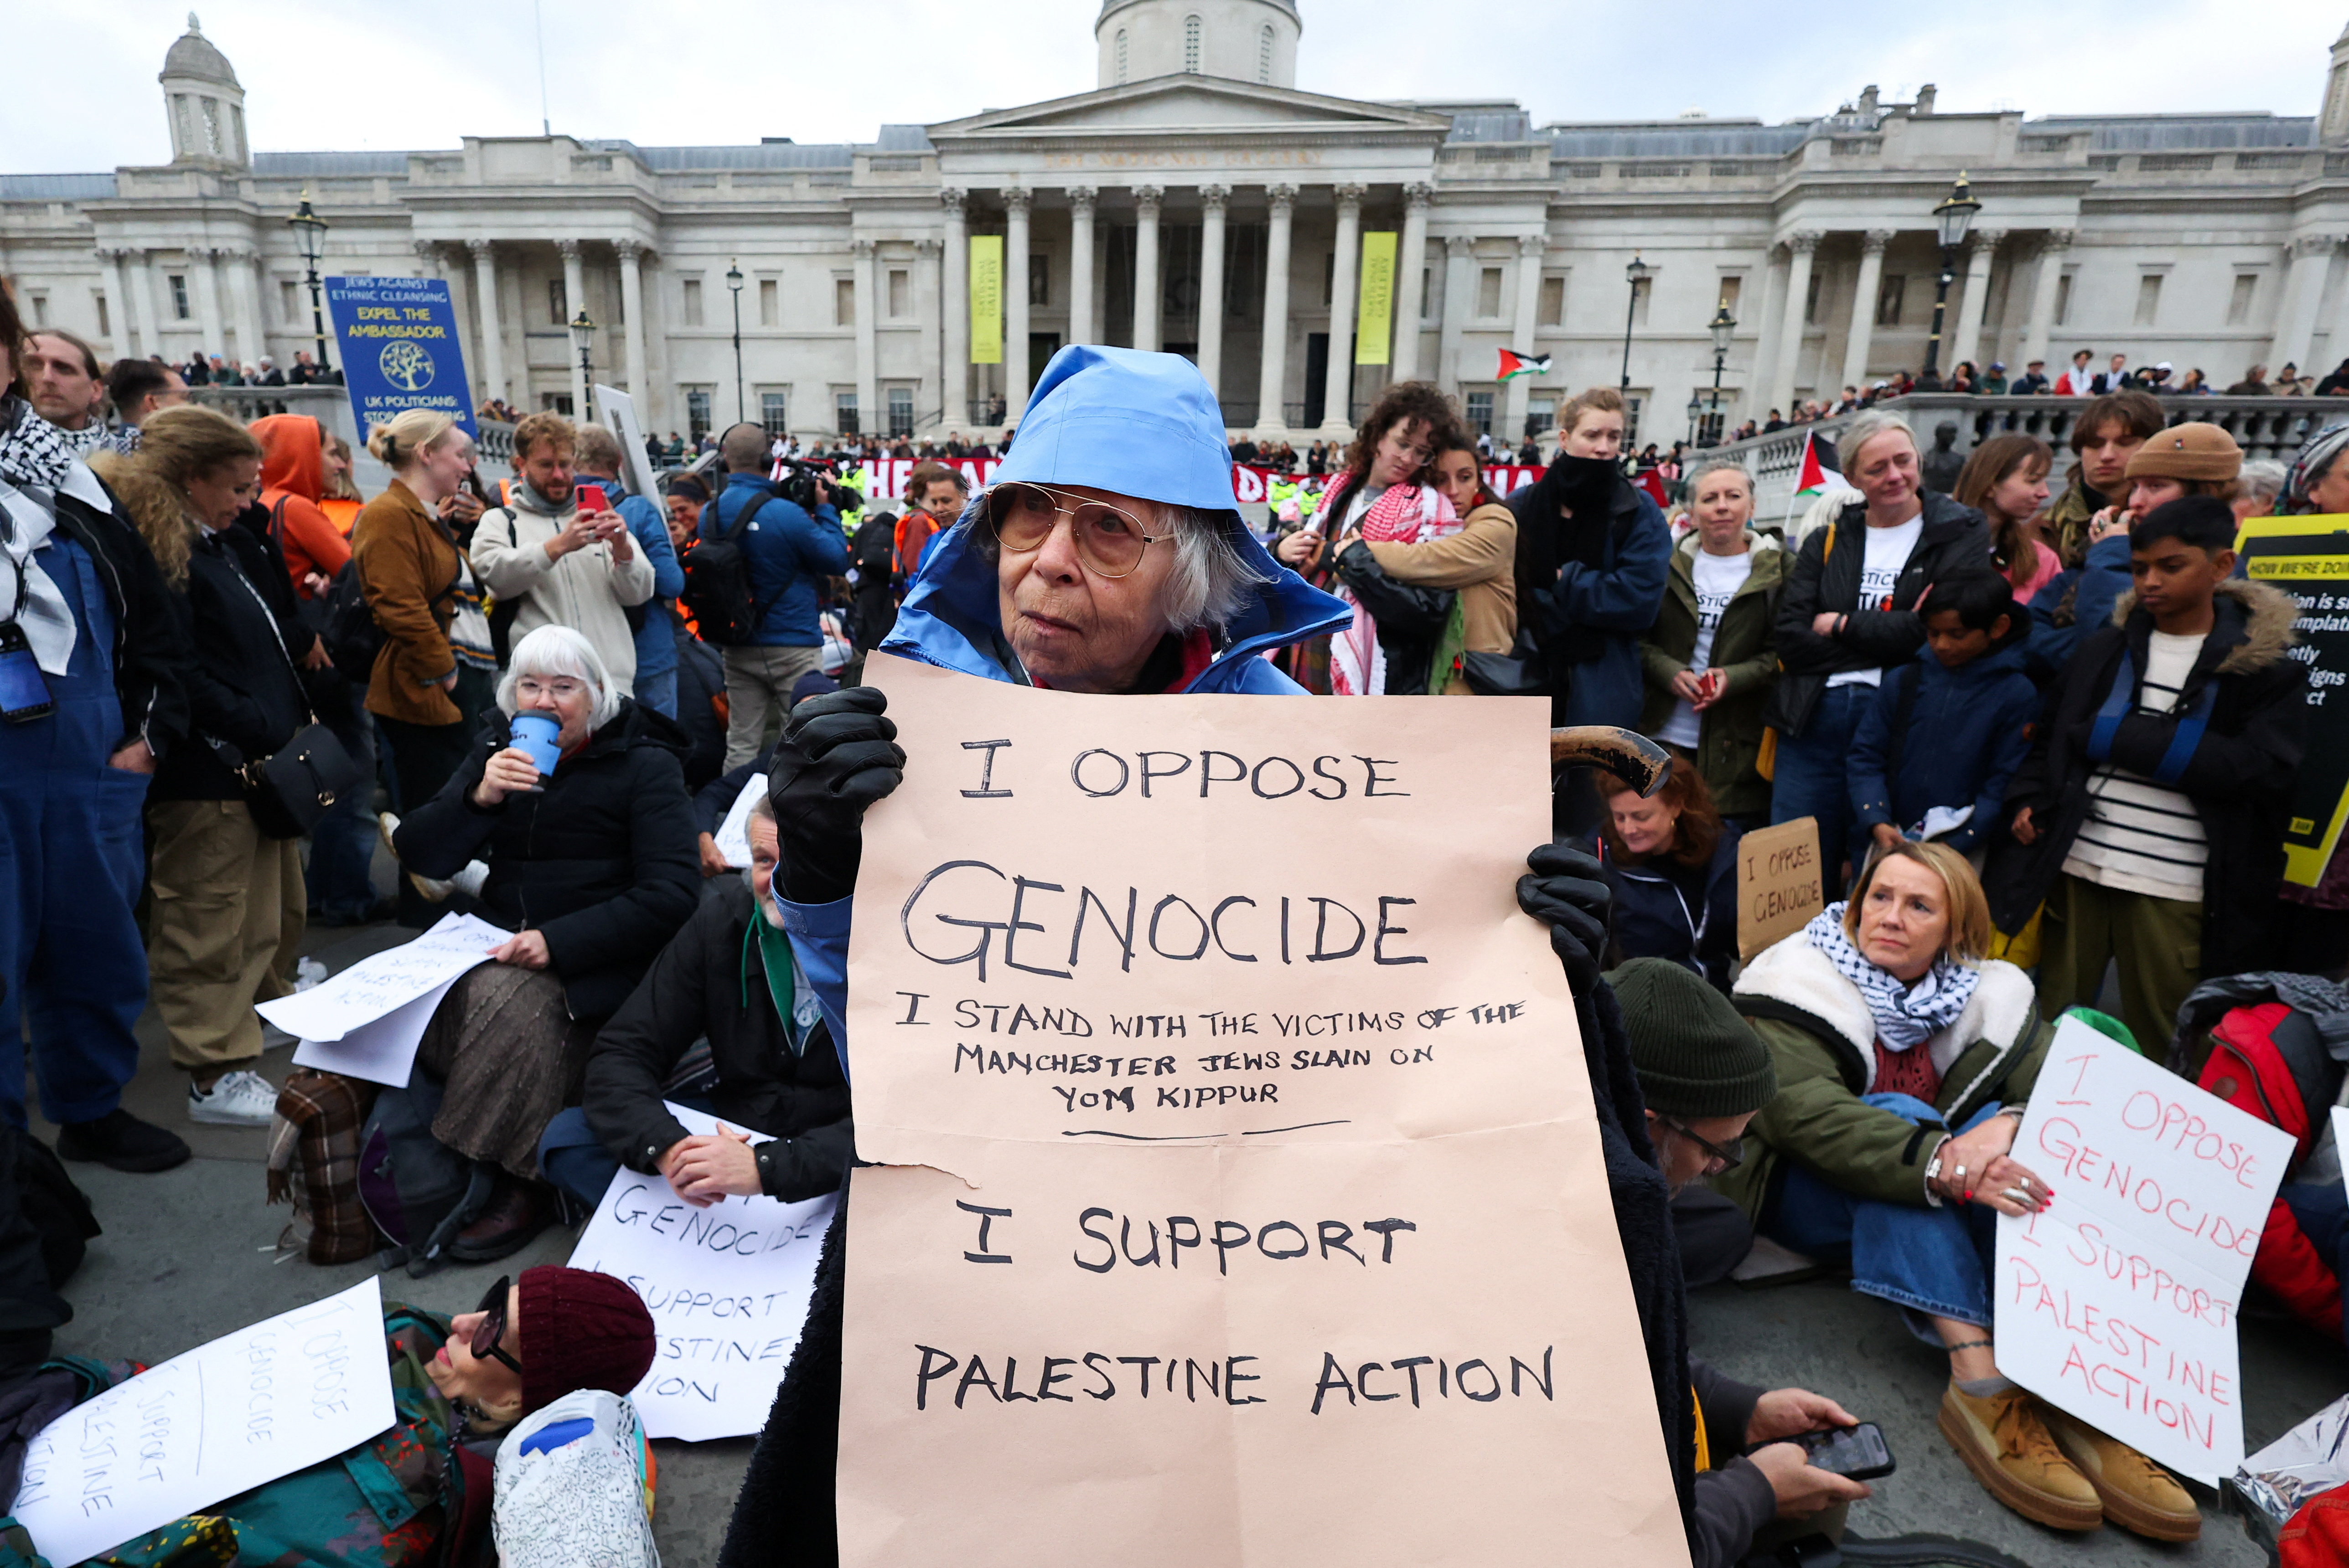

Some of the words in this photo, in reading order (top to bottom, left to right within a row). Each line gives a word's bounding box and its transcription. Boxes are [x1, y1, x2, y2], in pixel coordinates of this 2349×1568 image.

[331, 289, 379, 301] ETHNIC
[380, 290, 448, 303] CLEANSING
[378, 278, 429, 290] AGAINST
[348, 324, 447, 339] AMBASSADOR
[357, 306, 401, 320] EXPEL
[402, 307, 431, 321] THE
[365, 396, 384, 408] UK
[862, 459, 913, 500] HE
[2250, 562, 2278, 575] HOW
[2317, 592, 2335, 610] is
[2307, 666, 2347, 689] igns
[960, 739, 1013, 798] I
[1071, 748, 1410, 799] OPPOSE
[1746, 856, 1755, 882] I
[1768, 843, 1812, 878] OPPOSE
[901, 861, 1428, 983] GENOCIDE
[1754, 879, 1820, 923] GENOCIDE
[896, 992, 930, 1024] I
[955, 1000, 1092, 1037] STAND
[1110, 1015, 1185, 1037] WITH
[1199, 1011, 1258, 1036] THE
[1272, 1012, 1404, 1037] VICTIMS
[1418, 1007, 1458, 1029] OF
[1467, 1000, 1526, 1026] THE
[955, 1043, 1176, 1077] MANCHESTER
[1198, 1052, 1280, 1072] JEWS
[1291, 1050, 1370, 1070] SLAIN
[1391, 1046, 1433, 1064] ON
[1052, 1086, 1134, 1112] YOM
[1157, 1084, 1278, 1108] KIPPUR
[2055, 1053, 2100, 1106] I
[2121, 1090, 2261, 1189] OPPOSE
[2038, 1116, 2261, 1257] GENOCIDE
[614, 1185, 818, 1255] GENOCIDE
[957, 1199, 1012, 1264] I
[1074, 1207, 1416, 1276] SUPPORT
[2066, 1222, 2233, 1328] SUPPORT
[283, 1299, 355, 1330] I
[2009, 1255, 2231, 1406] PALESTINE
[654, 1334, 792, 1362] STINE
[233, 1331, 278, 1444] GENOCIDE
[302, 1329, 351, 1421] OPPOSE
[645, 1373, 719, 1403] ION
[915, 1345, 1267, 1410] PALESTINE
[1311, 1346, 1552, 1415] ACTION
[2059, 1341, 2214, 1450] ACTION
[79, 1389, 127, 1518] PALESTINE
[136, 1389, 175, 1483] SUPPORT
